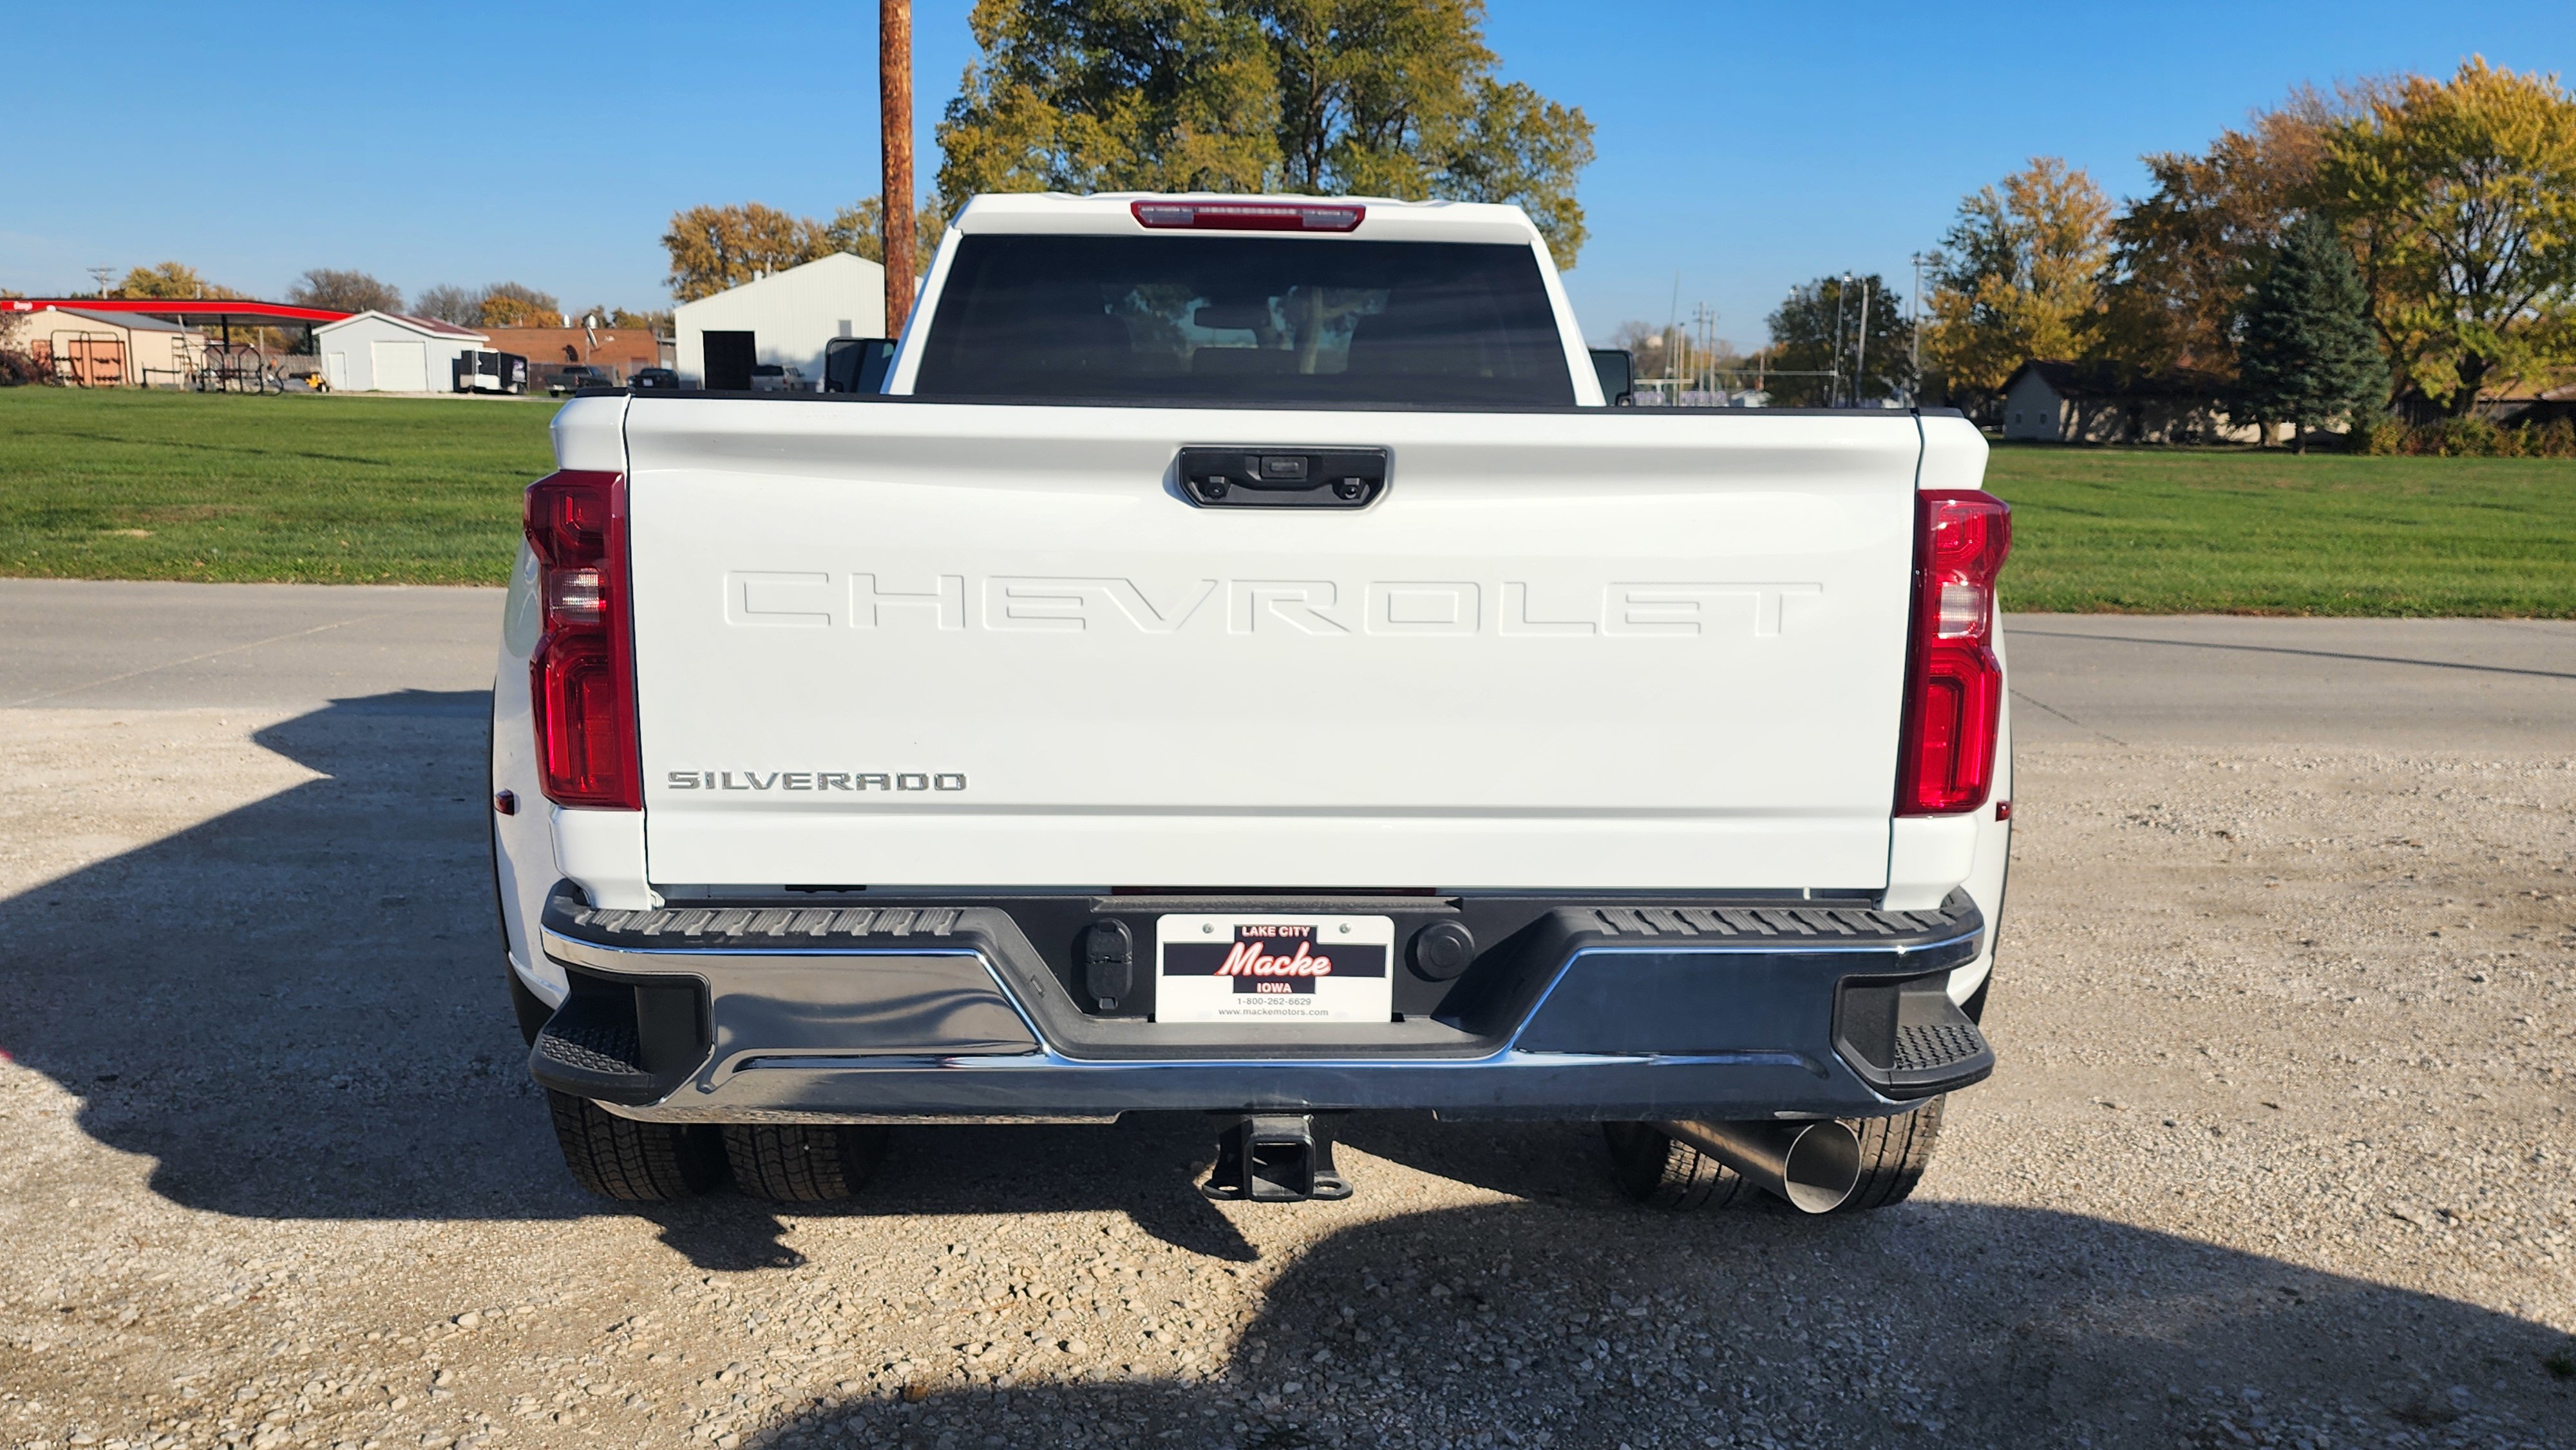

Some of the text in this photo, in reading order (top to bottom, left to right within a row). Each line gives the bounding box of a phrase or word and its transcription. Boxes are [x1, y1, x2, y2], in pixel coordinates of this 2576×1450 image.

[723, 570, 1824, 635] CHEVROLET
[668, 771, 967, 791] SILVERADO
[1242, 926, 1310, 937] LAKE CITY
[1214, 941, 1331, 977] Macke
[1257, 983, 1292, 993] IOWA
[1218, 1008, 1329, 1016] www.mackemotors.com
